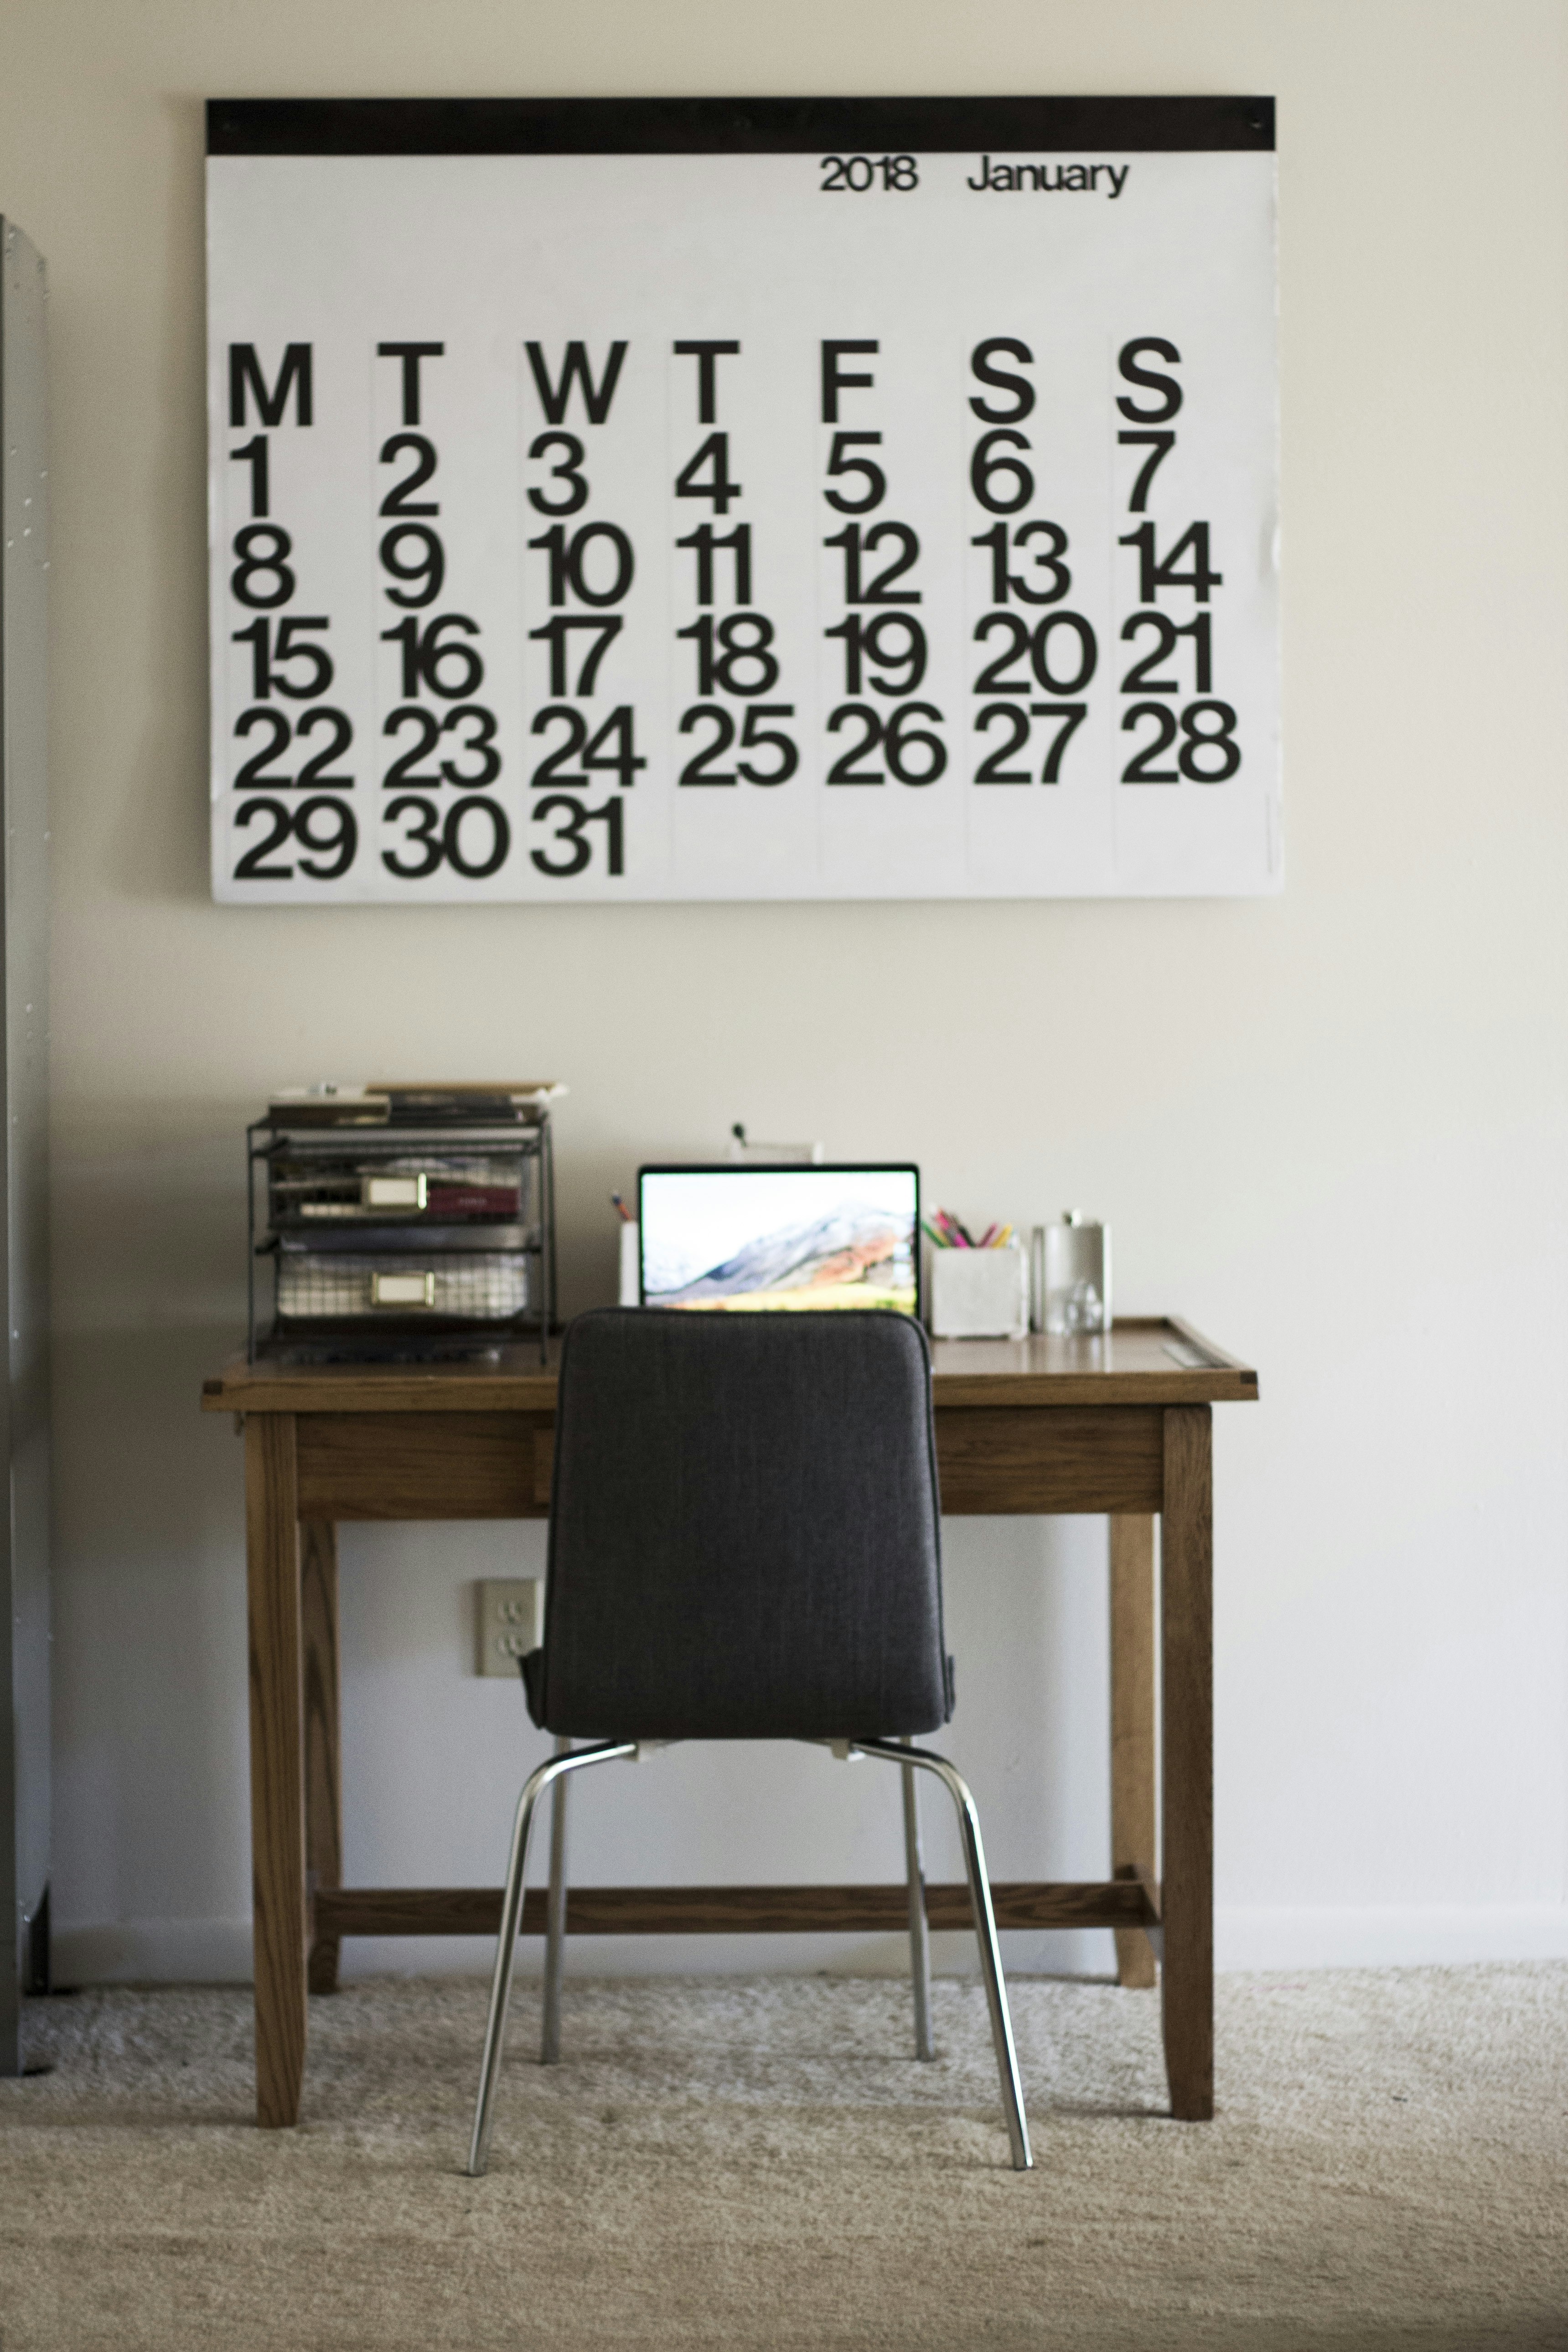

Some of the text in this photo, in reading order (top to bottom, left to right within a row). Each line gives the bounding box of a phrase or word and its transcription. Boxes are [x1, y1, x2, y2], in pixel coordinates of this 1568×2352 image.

[819, 153, 1130, 200] 2018 January
[228, 337, 1183, 428] M T W T F S S
[229, 428, 1176, 518] 1 2 3 4 5 6 7
[230, 520, 1223, 611] 8 9 10 11 12 13 14
[231, 610, 1212, 701] 15 16 17 18 19 20 21
[233, 699, 1242, 791] 22 23 24 25 26 27 28
[233, 794, 624, 881] 29 30 31
